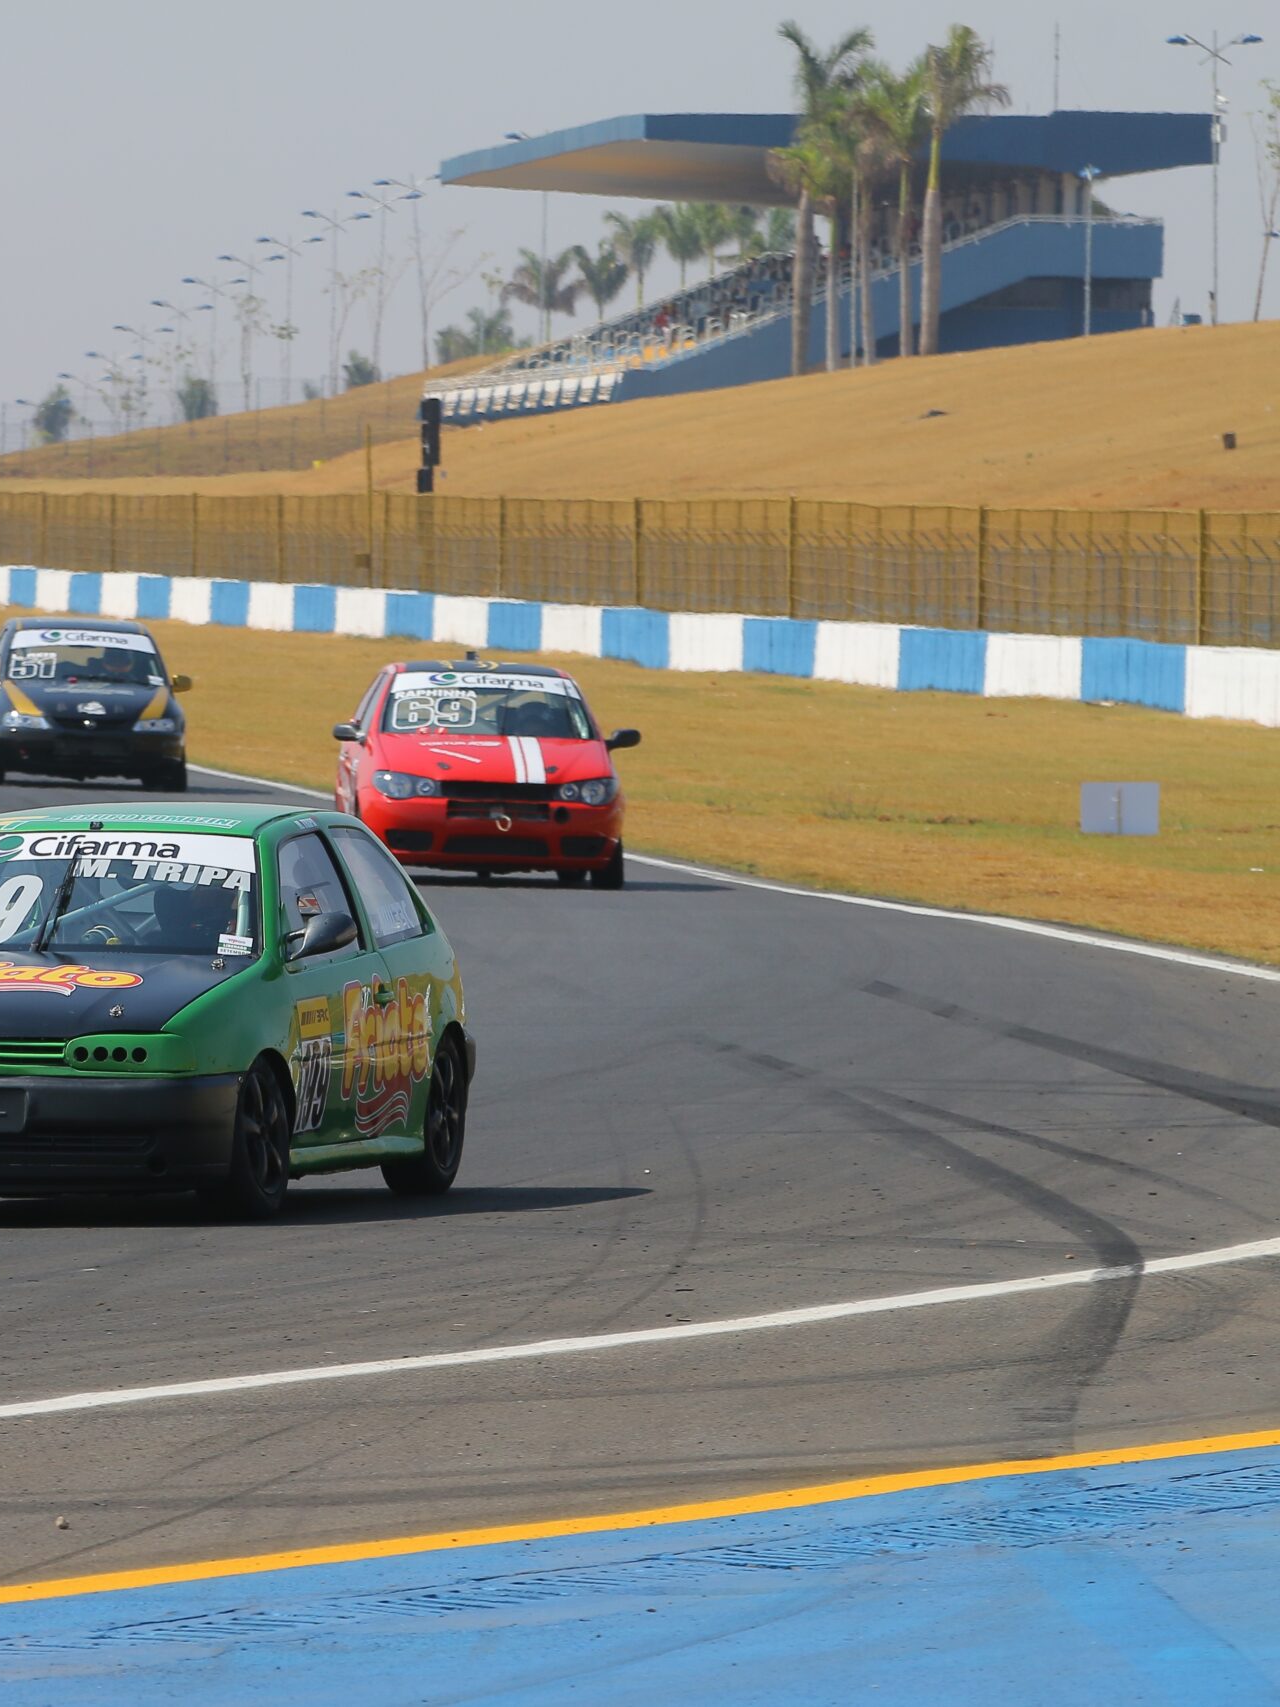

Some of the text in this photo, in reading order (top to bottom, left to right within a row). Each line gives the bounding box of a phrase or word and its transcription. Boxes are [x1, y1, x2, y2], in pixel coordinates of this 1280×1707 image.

[65, 632, 128, 645] Cifarma
[9, 656, 56, 680] 51
[462, 675, 544, 689] Cifarma
[394, 689, 477, 700] RAPHINHA
[392, 697, 476, 730] 69
[28, 834, 181, 859] Cifarma
[73, 859, 251, 892] M. TRIPA
[341, 973, 430, 1101] Friato
